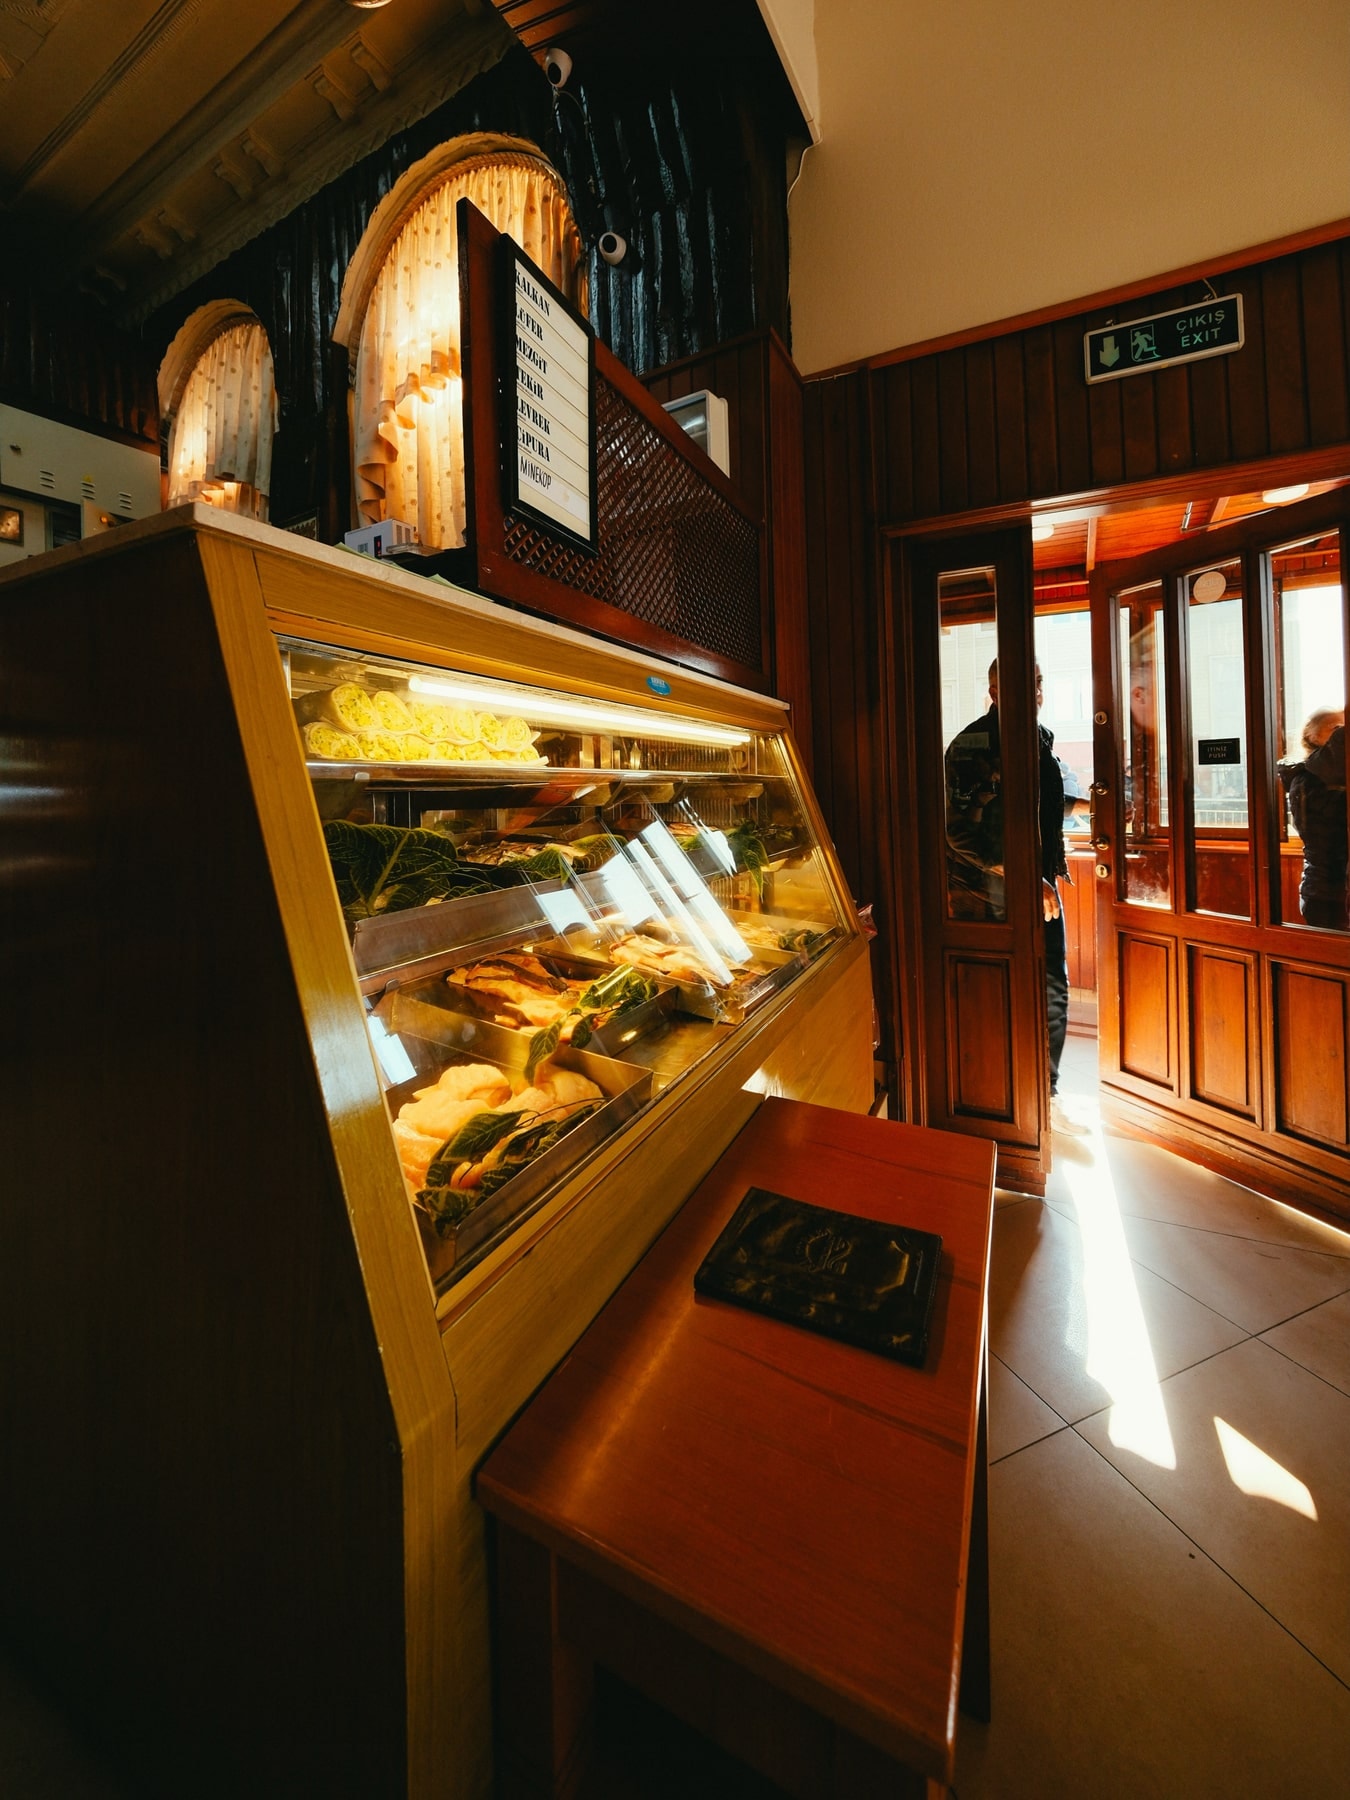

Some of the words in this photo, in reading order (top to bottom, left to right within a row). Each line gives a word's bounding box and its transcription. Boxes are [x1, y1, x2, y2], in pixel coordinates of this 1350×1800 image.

[516, 271, 550, 316] KALKAN
[1176, 309, 1225, 333] ÇIKIŞ
[1181, 327, 1221, 347] EXIT
